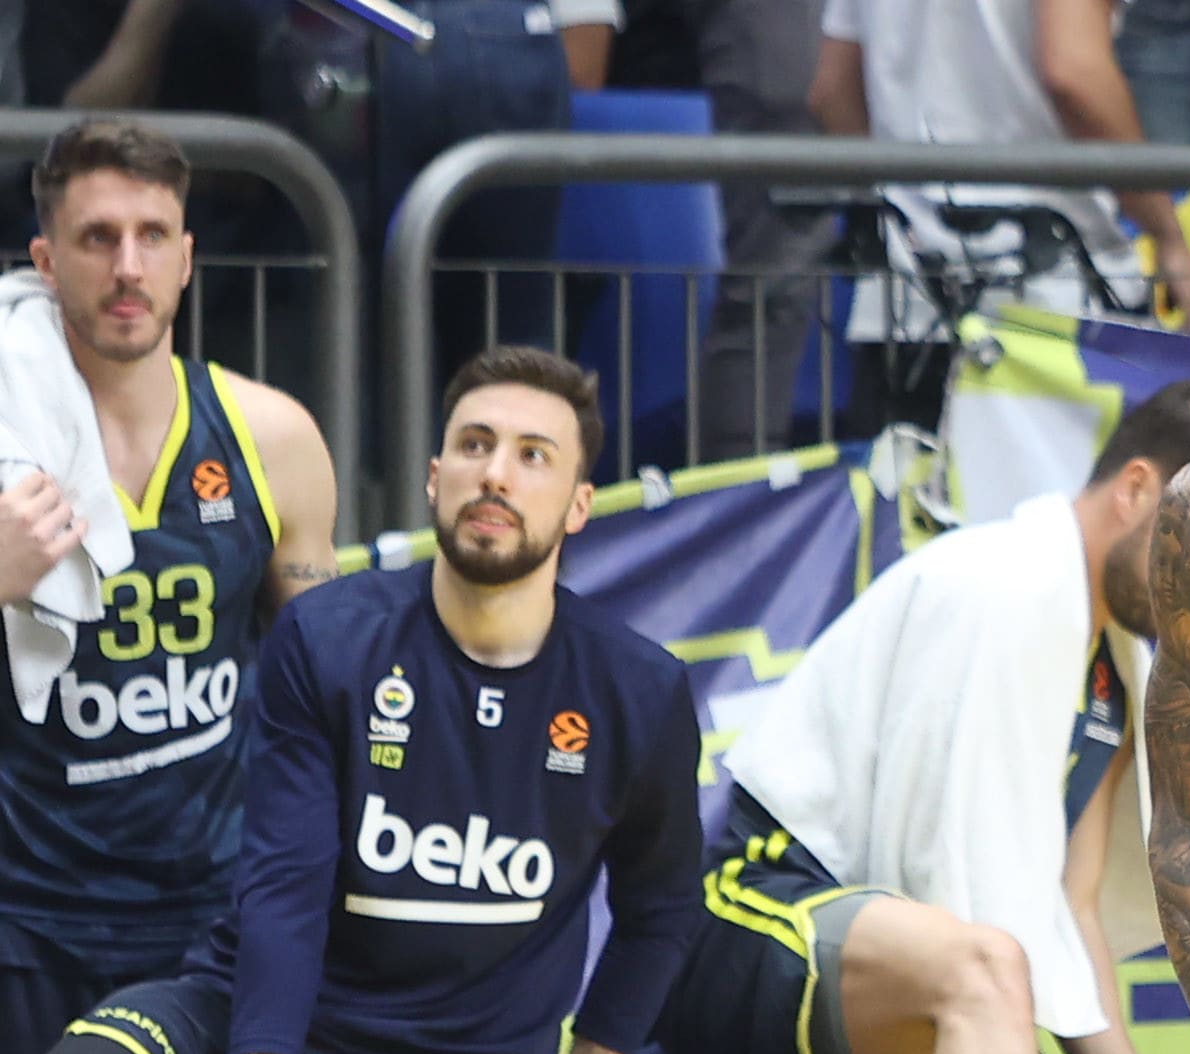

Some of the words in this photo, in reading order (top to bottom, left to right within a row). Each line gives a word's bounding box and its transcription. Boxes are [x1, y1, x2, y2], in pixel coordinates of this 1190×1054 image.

[98, 564, 216, 661] 33
[59, 656, 238, 740] beko
[476, 687, 505, 727] 5
[357, 794, 554, 899] beko
